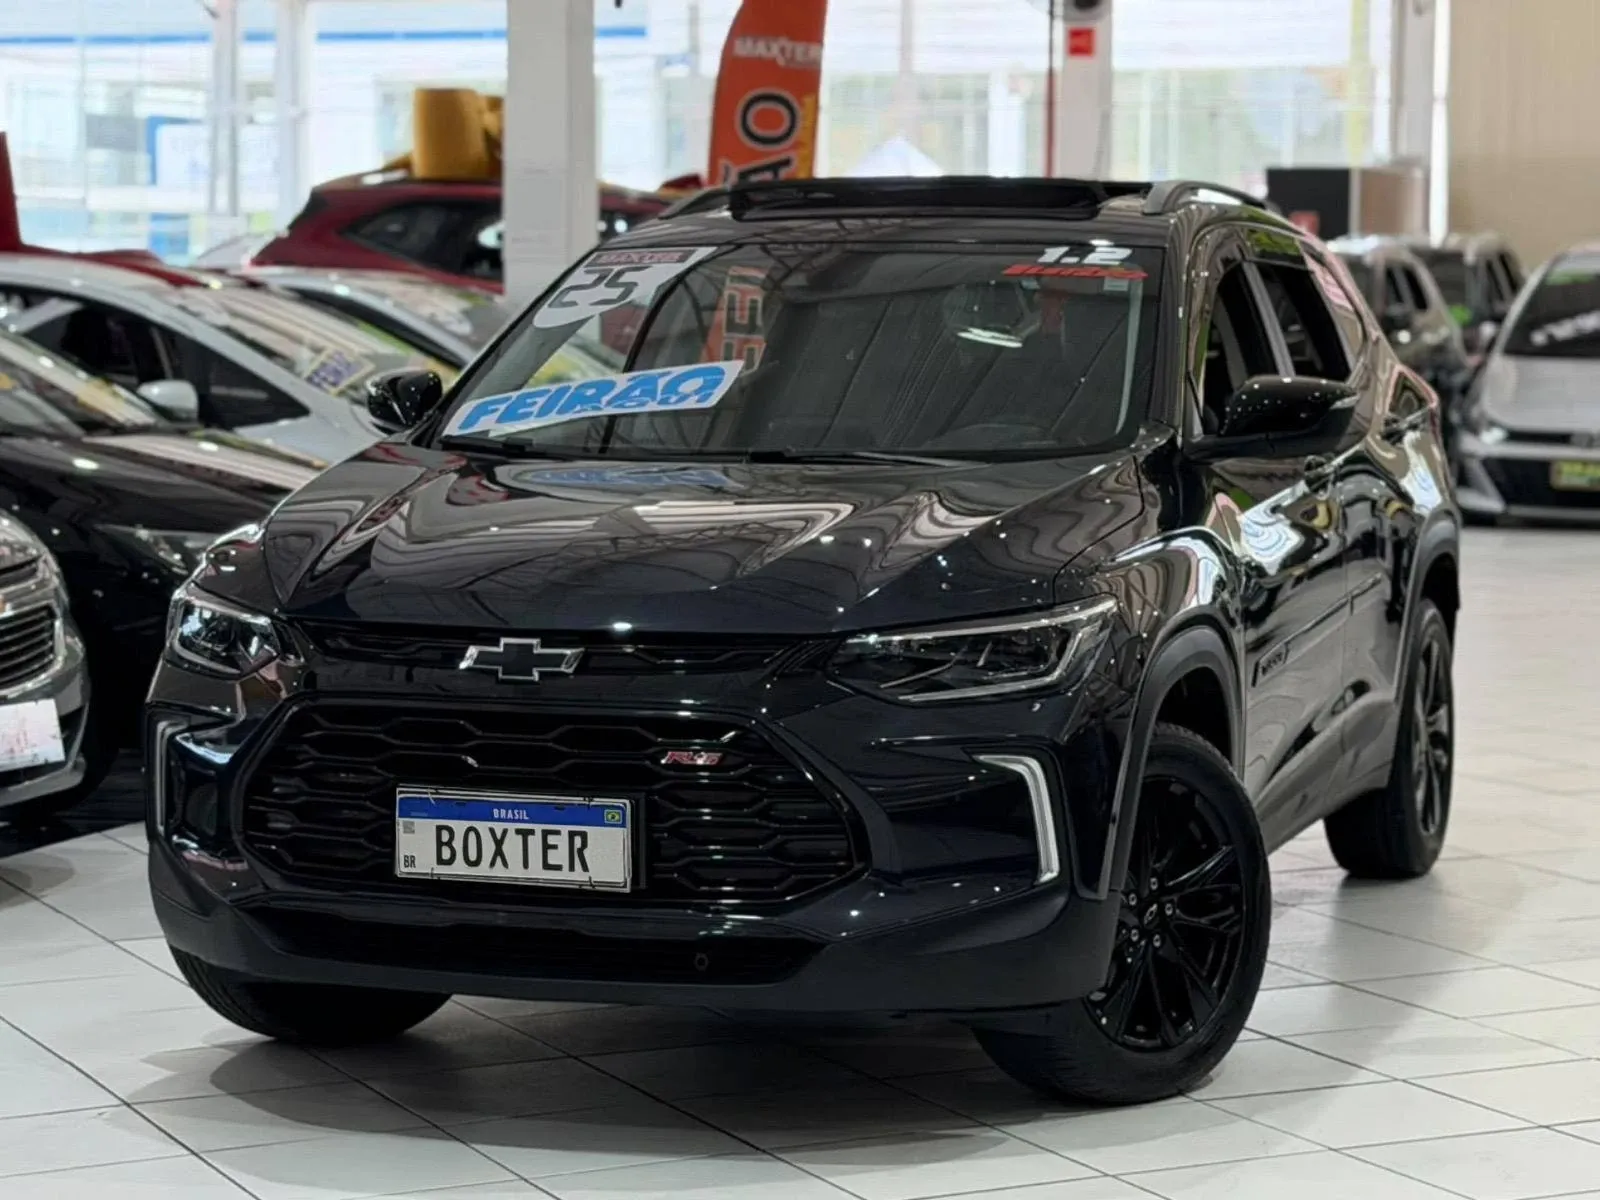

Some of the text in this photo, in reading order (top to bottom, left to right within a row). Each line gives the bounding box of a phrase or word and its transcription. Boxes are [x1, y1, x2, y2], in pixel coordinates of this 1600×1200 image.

[1036, 246, 1133, 265] 1.2
[547, 265, 653, 309] 25
[492, 808, 529, 820] BRASIL
[435, 824, 590, 873] BOXTER
[403, 855, 416, 868] BR
